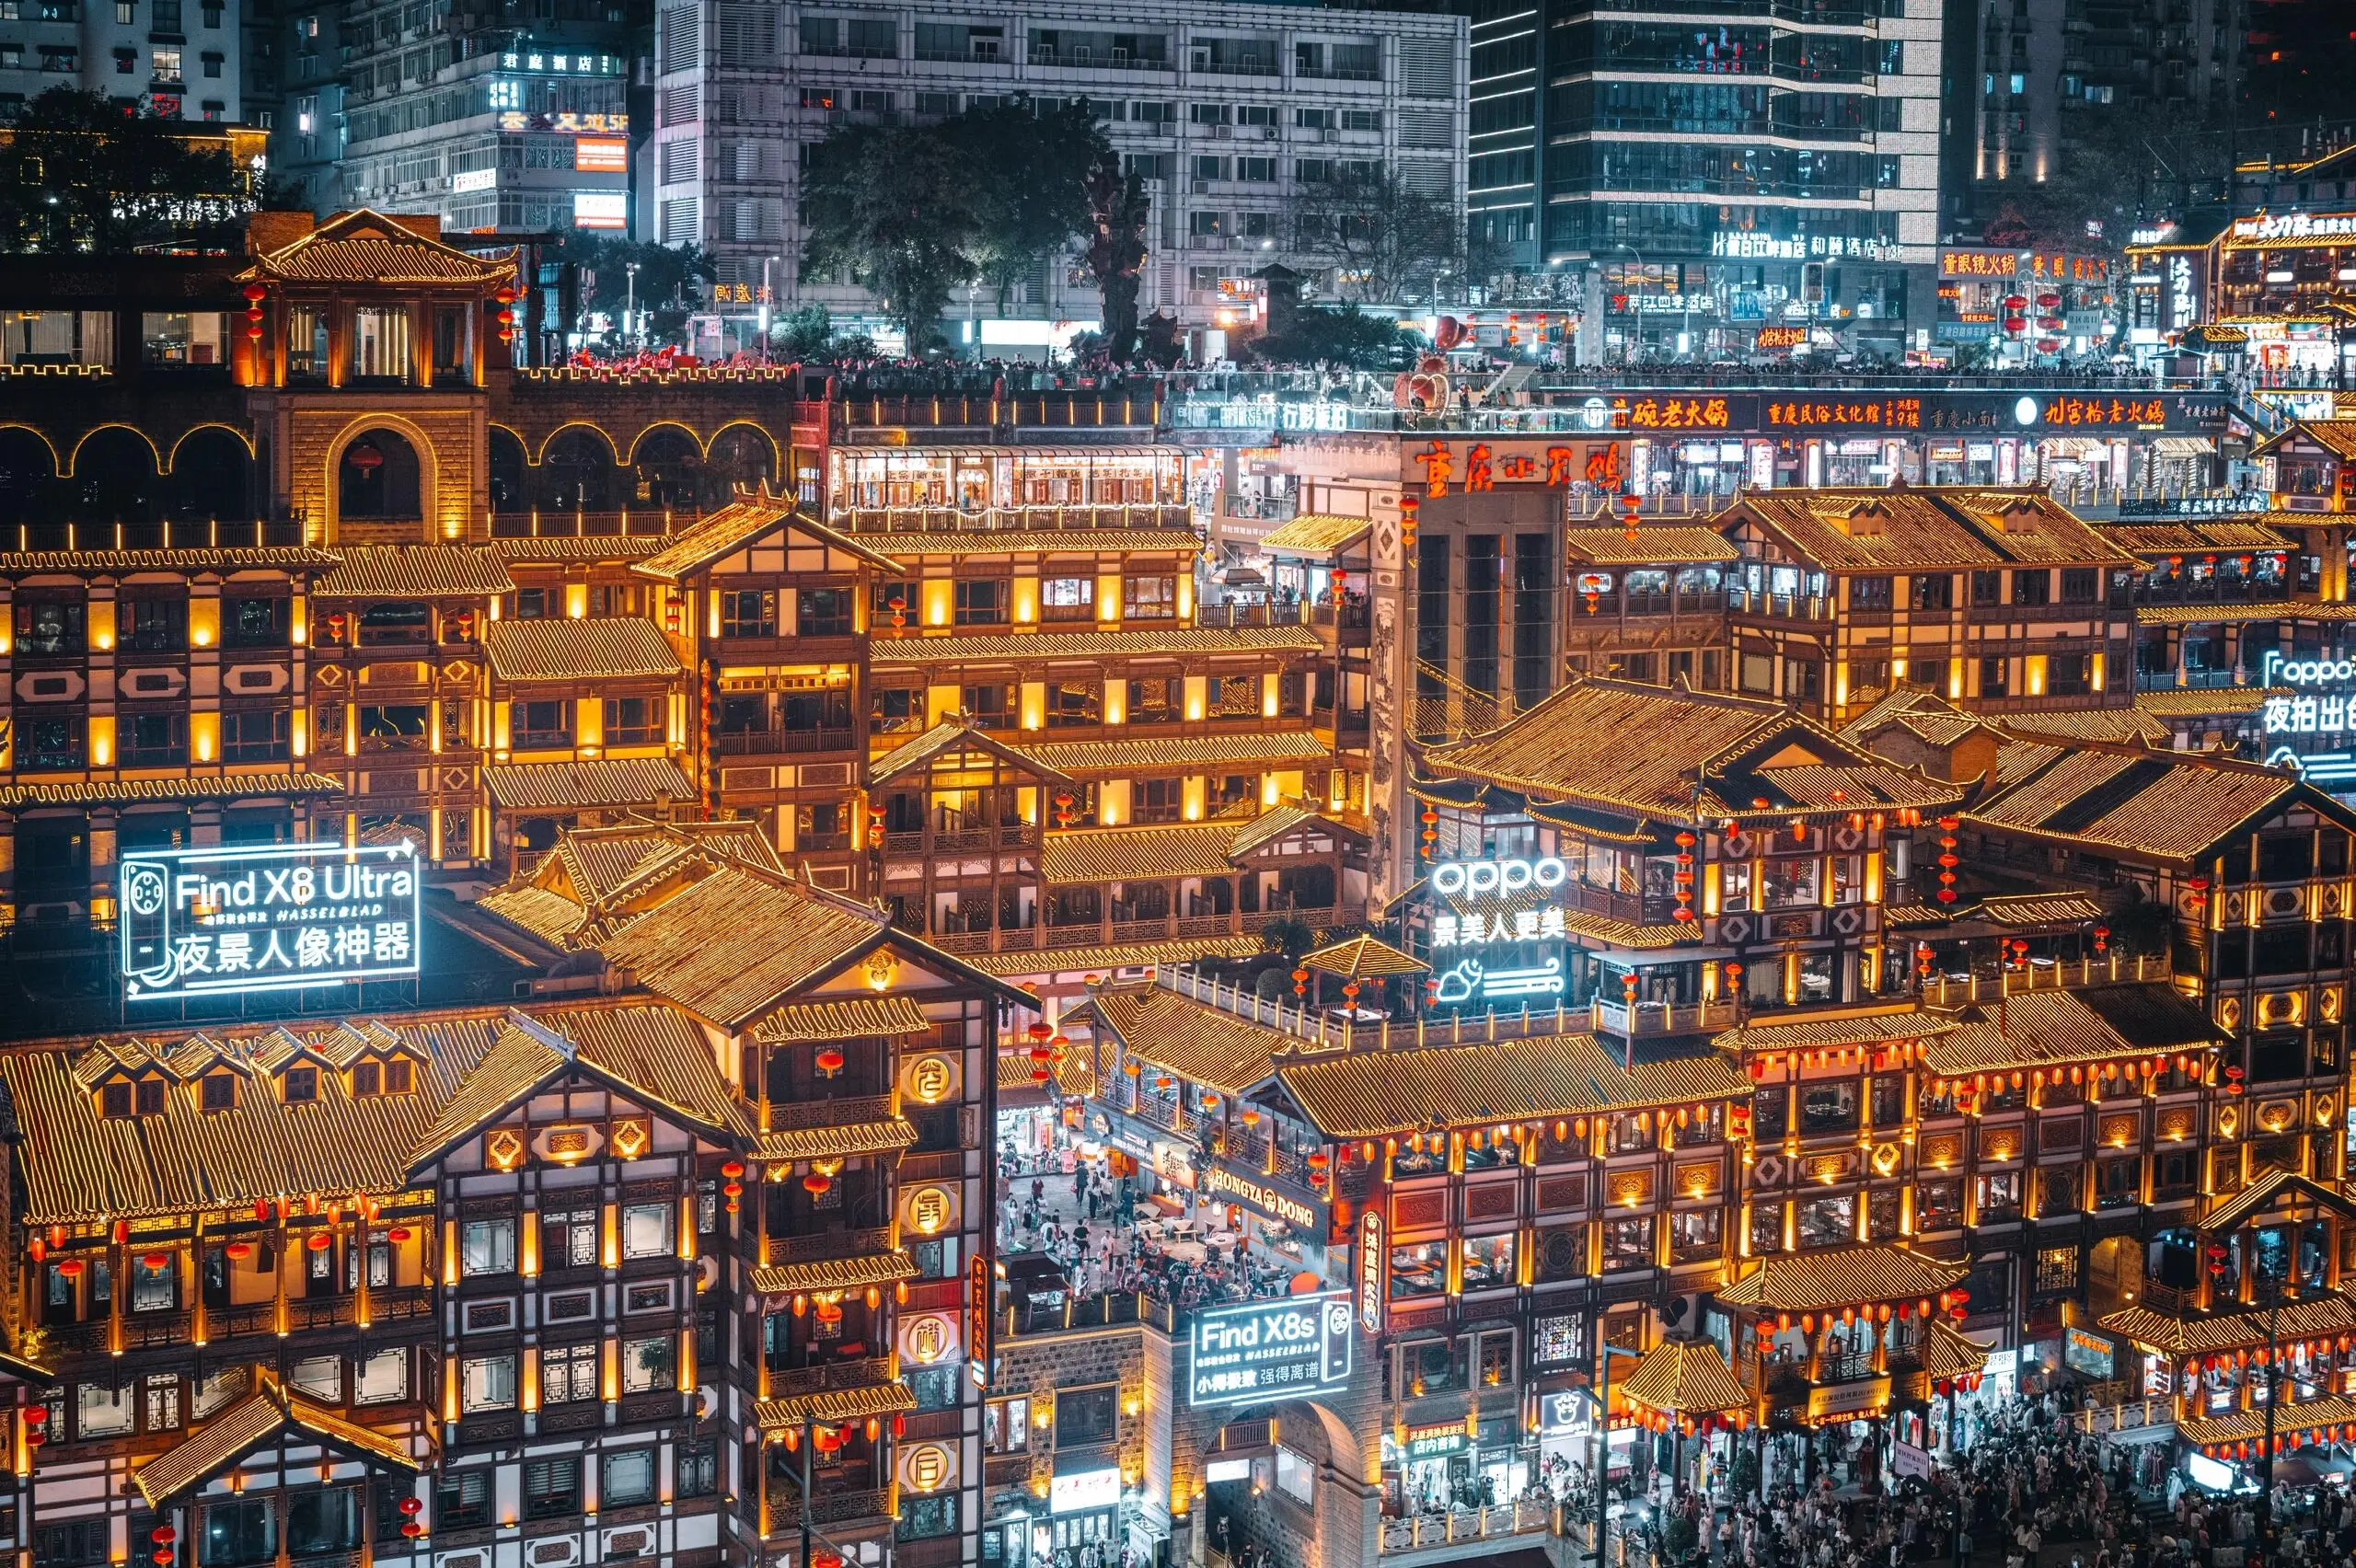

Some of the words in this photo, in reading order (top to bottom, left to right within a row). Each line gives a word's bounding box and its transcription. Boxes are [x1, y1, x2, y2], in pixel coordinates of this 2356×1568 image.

[503, 53, 592, 71] 君庭酒店
[1943, 253, 2015, 275] 董眼镜火锅
[1897, 411, 1920, 428] 9楼
[2045, 397, 2165, 425] 九宫格老火锅
[176, 871, 255, 910] Find
[263, 867, 316, 905] X8
[325, 864, 412, 900] Ultra
[276, 904, 382, 922] HASSELBLAD
[176, 921, 410, 975] 夜景人像神器
[1214, 1169, 1264, 1205] HONGYA
[1276, 1196, 1314, 1228] DONG
[1201, 1319, 1258, 1351] Find
[1264, 1312, 1315, 1343] X8s
[1245, 1343, 1321, 1361] HASSELBLAD
[1261, 1362, 1319, 1385] 强得离谱
